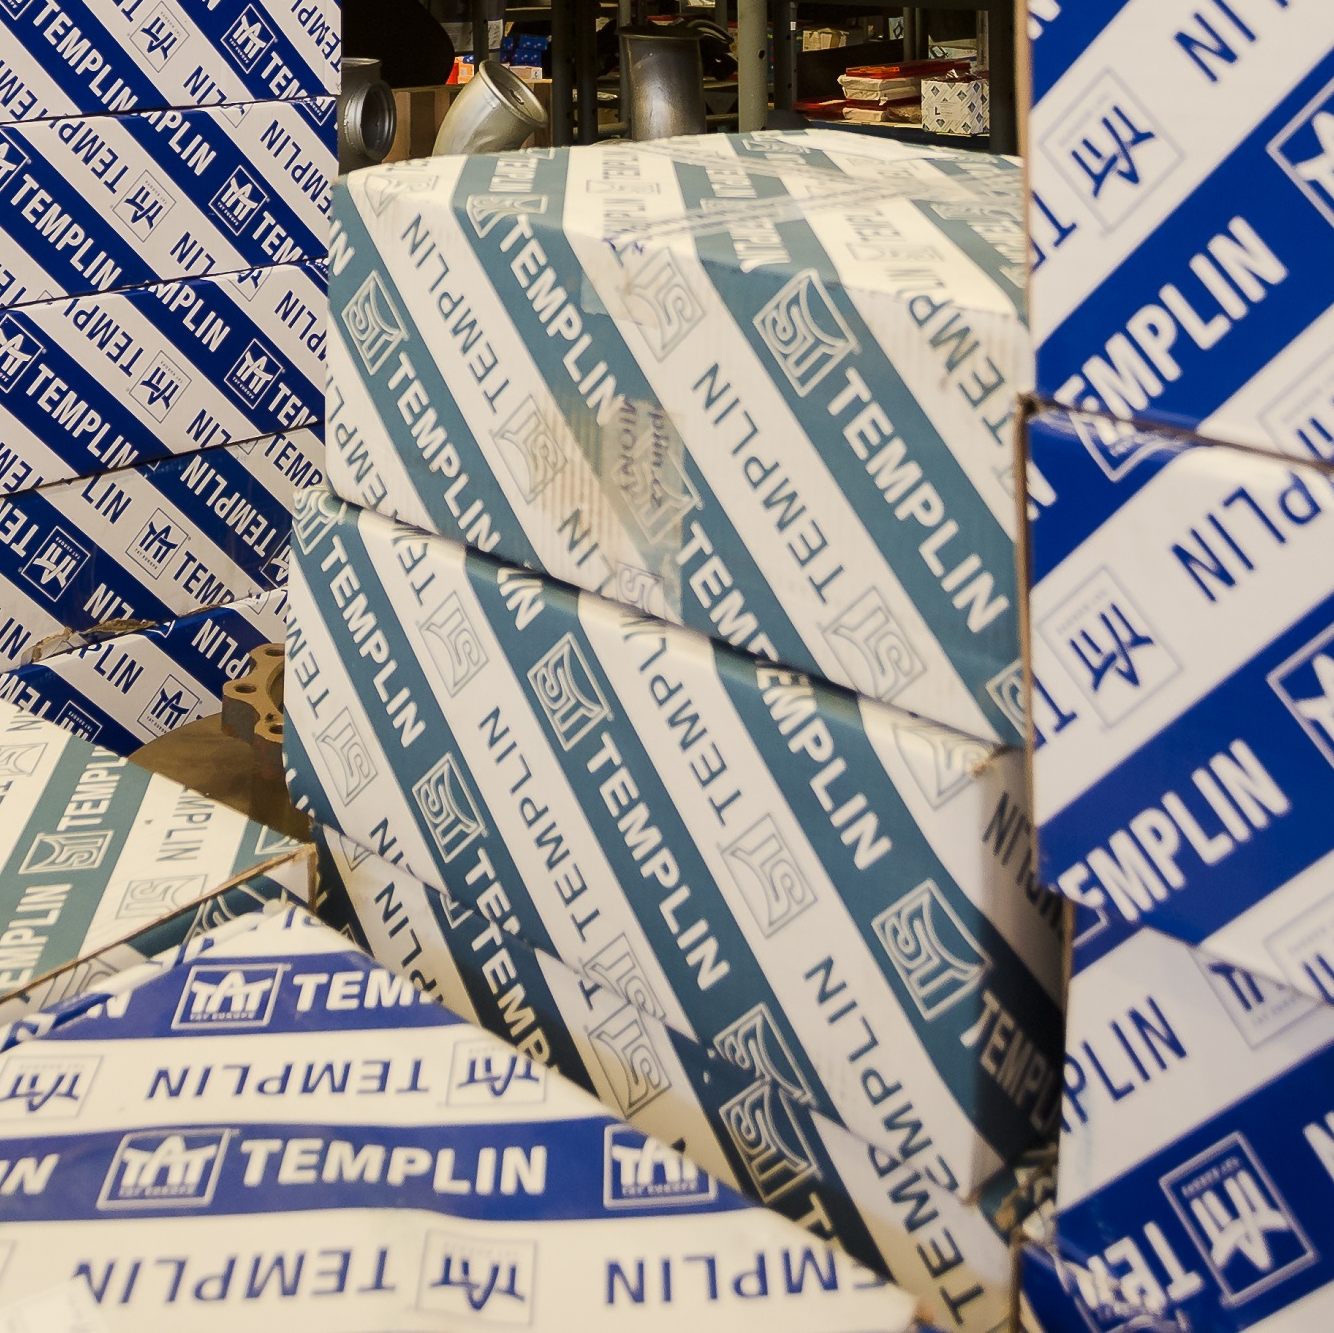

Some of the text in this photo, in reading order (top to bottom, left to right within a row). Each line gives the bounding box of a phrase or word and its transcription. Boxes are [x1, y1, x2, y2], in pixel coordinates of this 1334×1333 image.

[10, 173, 122, 292] TEMPLIN
[401, 213, 513, 415] TEMPLIN
[499, 214, 624, 426] TEMPLIN
[1053, 214, 1290, 425] EMPLIN
[26, 363, 138, 469] TEMPLIN
[180, 455, 277, 558] TEMPLIN
[386, 352, 501, 554] TEMPLIN
[692, 362, 849, 602] TEMPLIN
[825, 368, 1009, 634] TEMPLIN
[320, 535, 425, 748] TEMPLIN
[478, 706, 604, 943] TEMPLIN
[582, 731, 731, 992] TEMPLIN
[757, 668, 892, 871] EMPLIN
[1057, 738, 1291, 923] EMPLIN
[145, 1058, 430, 1100] TEMPLIN
[471, 918, 553, 1069] TEMP
[960, 989, 1061, 1134] TEMPL
[1063, 996, 1188, 1135] PLIN
[240, 1137, 548, 1196] TEMPLIN
[73, 1245, 397, 1305] TEMPLIN
[604, 1246, 839, 1307] MPLIN
